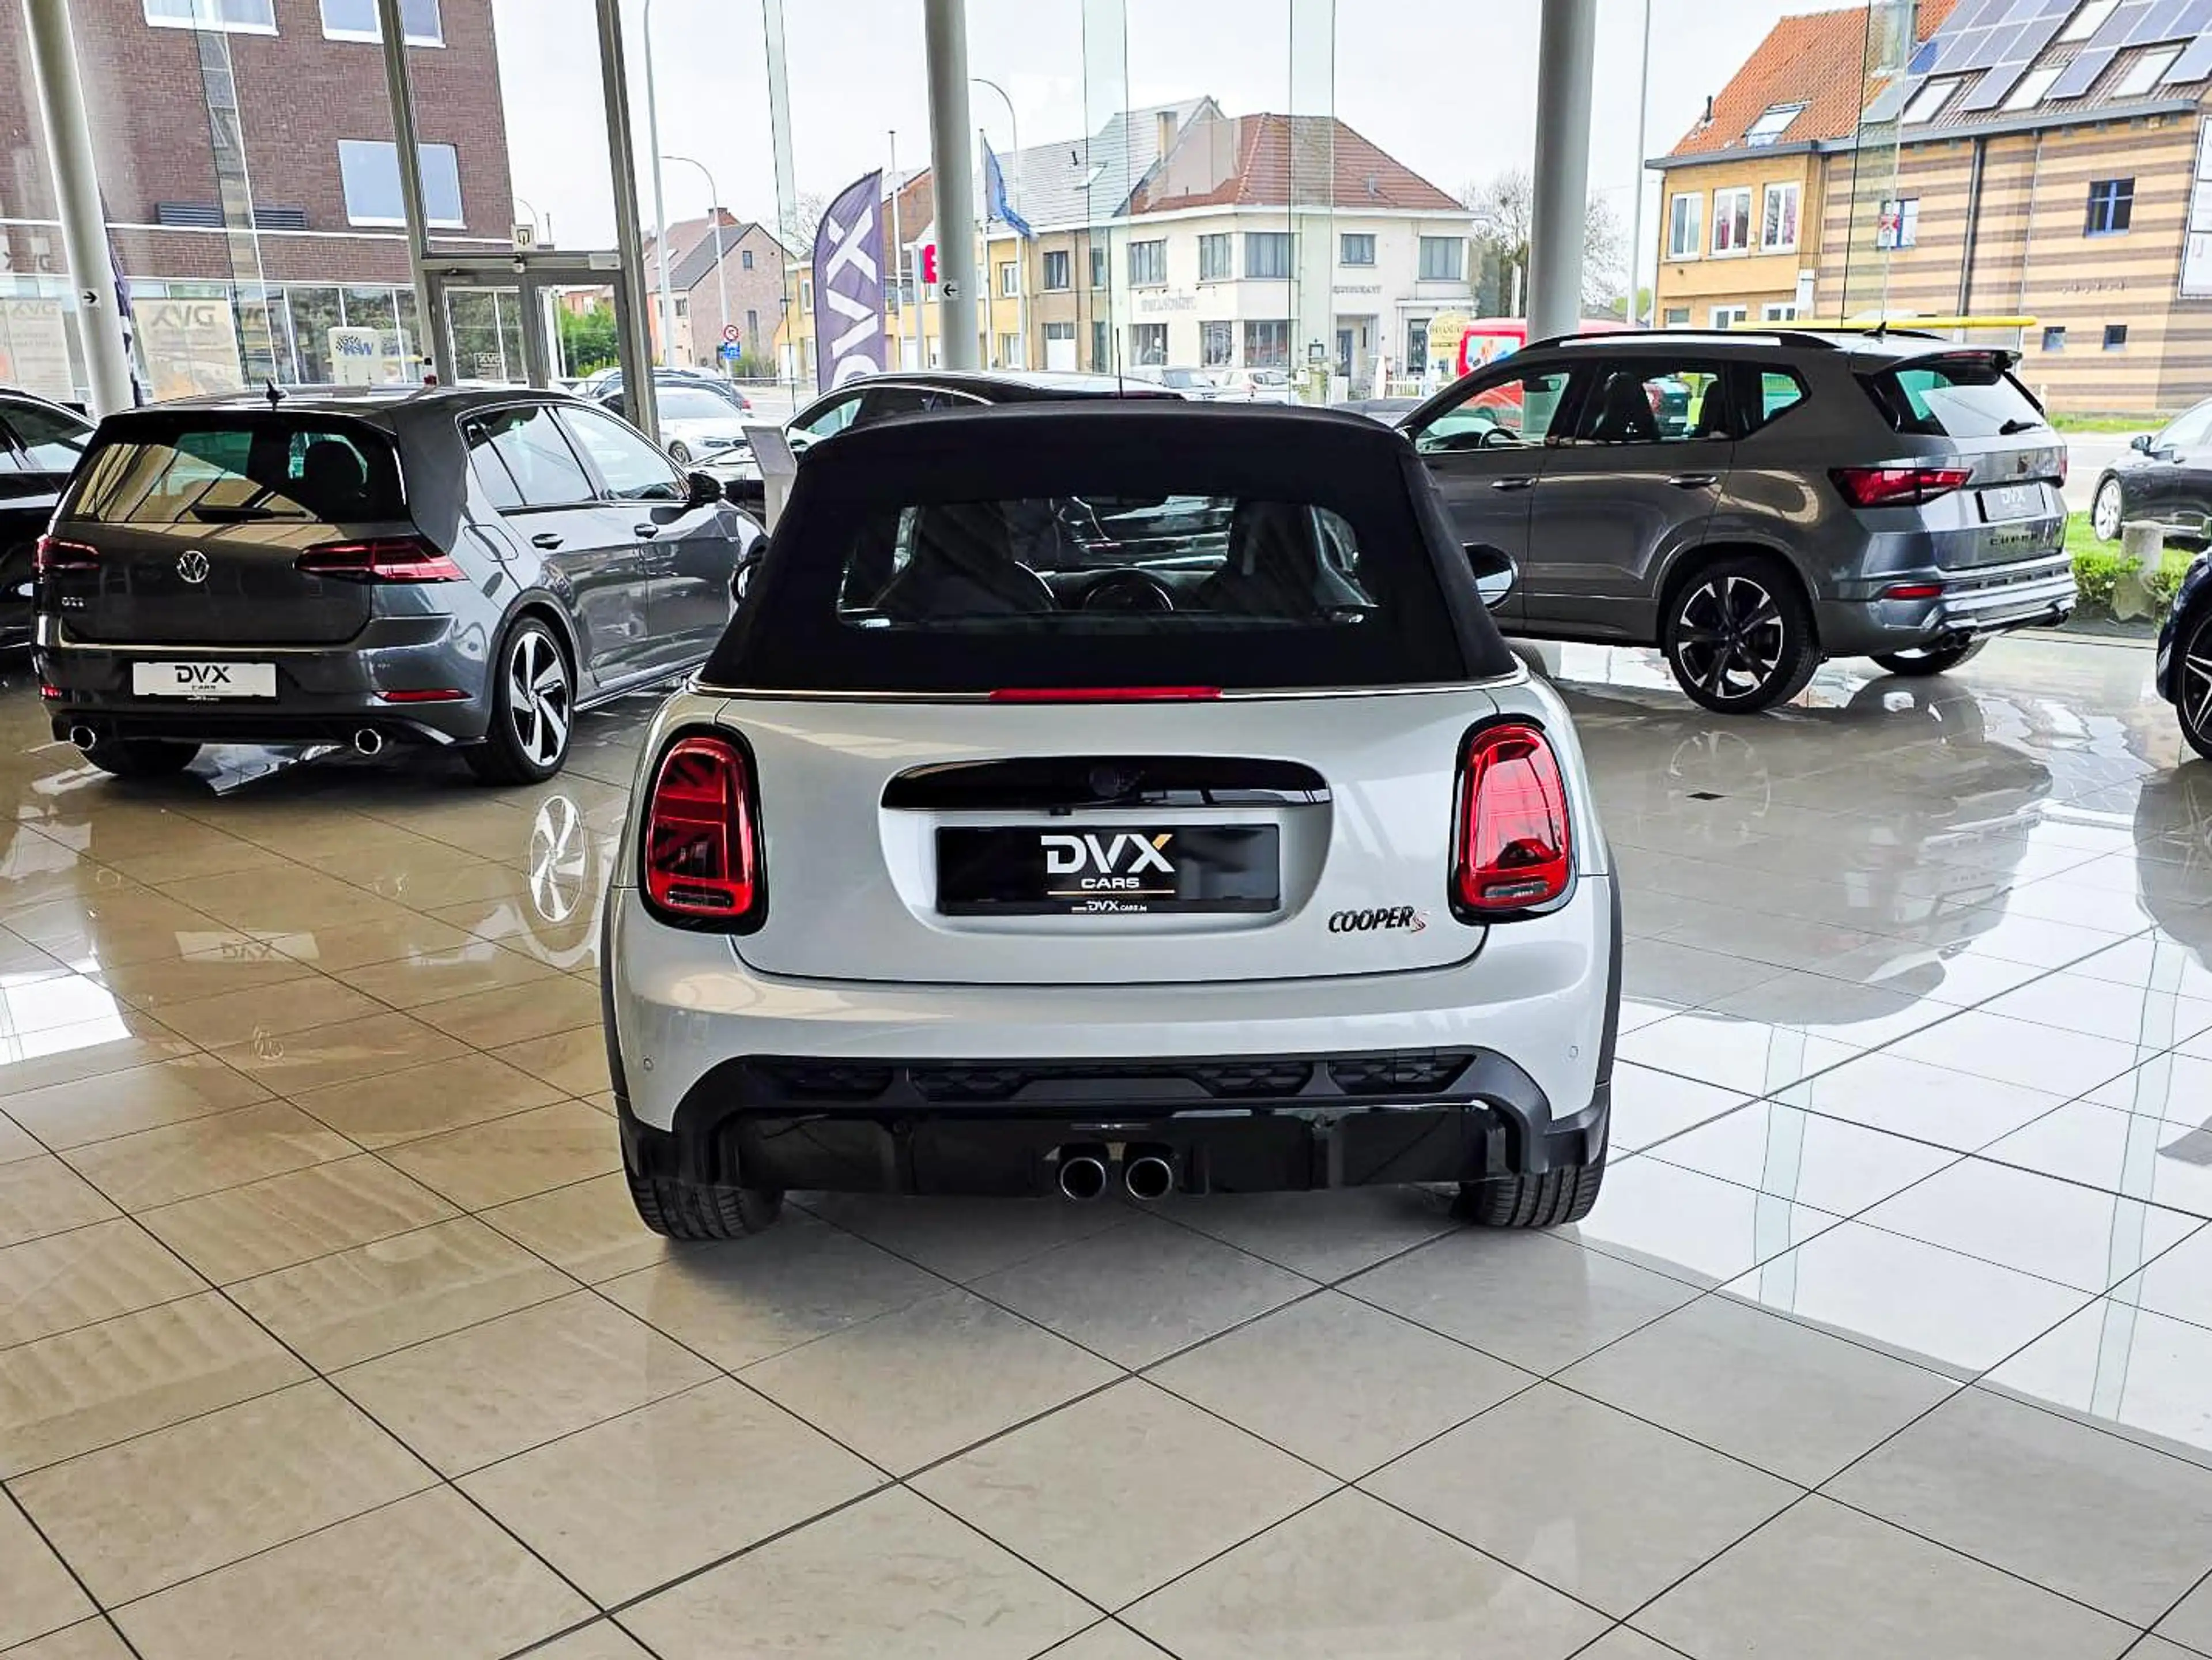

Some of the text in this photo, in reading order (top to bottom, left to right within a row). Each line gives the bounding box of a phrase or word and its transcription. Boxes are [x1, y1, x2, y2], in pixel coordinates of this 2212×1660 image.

[175, 665, 231, 682] DVX
[1041, 834, 1176, 873] DVX
[1081, 877, 1139, 889] CARS
[1328, 906, 1414, 933] COOPER
